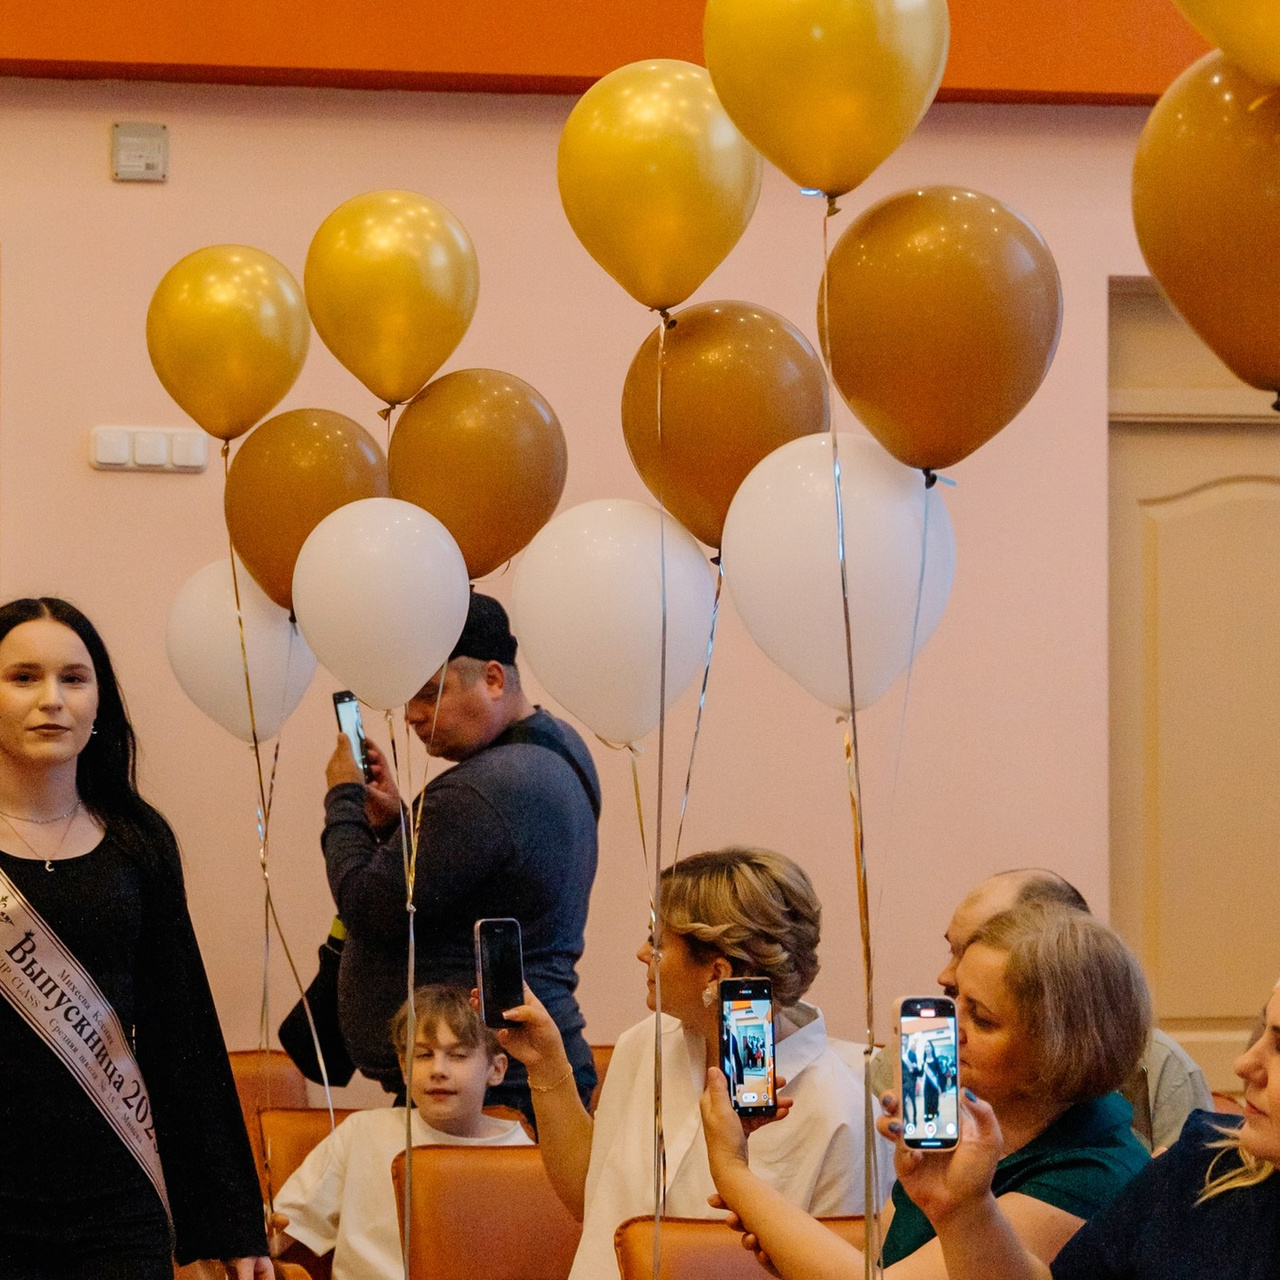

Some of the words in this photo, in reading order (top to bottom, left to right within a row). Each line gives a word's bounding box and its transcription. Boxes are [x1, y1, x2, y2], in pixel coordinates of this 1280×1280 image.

[4, 934, 125, 1093] Выпускница
[10, 975, 41, 1009] CLASS
[58, 969, 92, 1011] Михеева
[92, 1010, 115, 1046] Ксения
[48, 1018, 79, 1054] Средняя
[78, 1055, 99, 1081] школа
